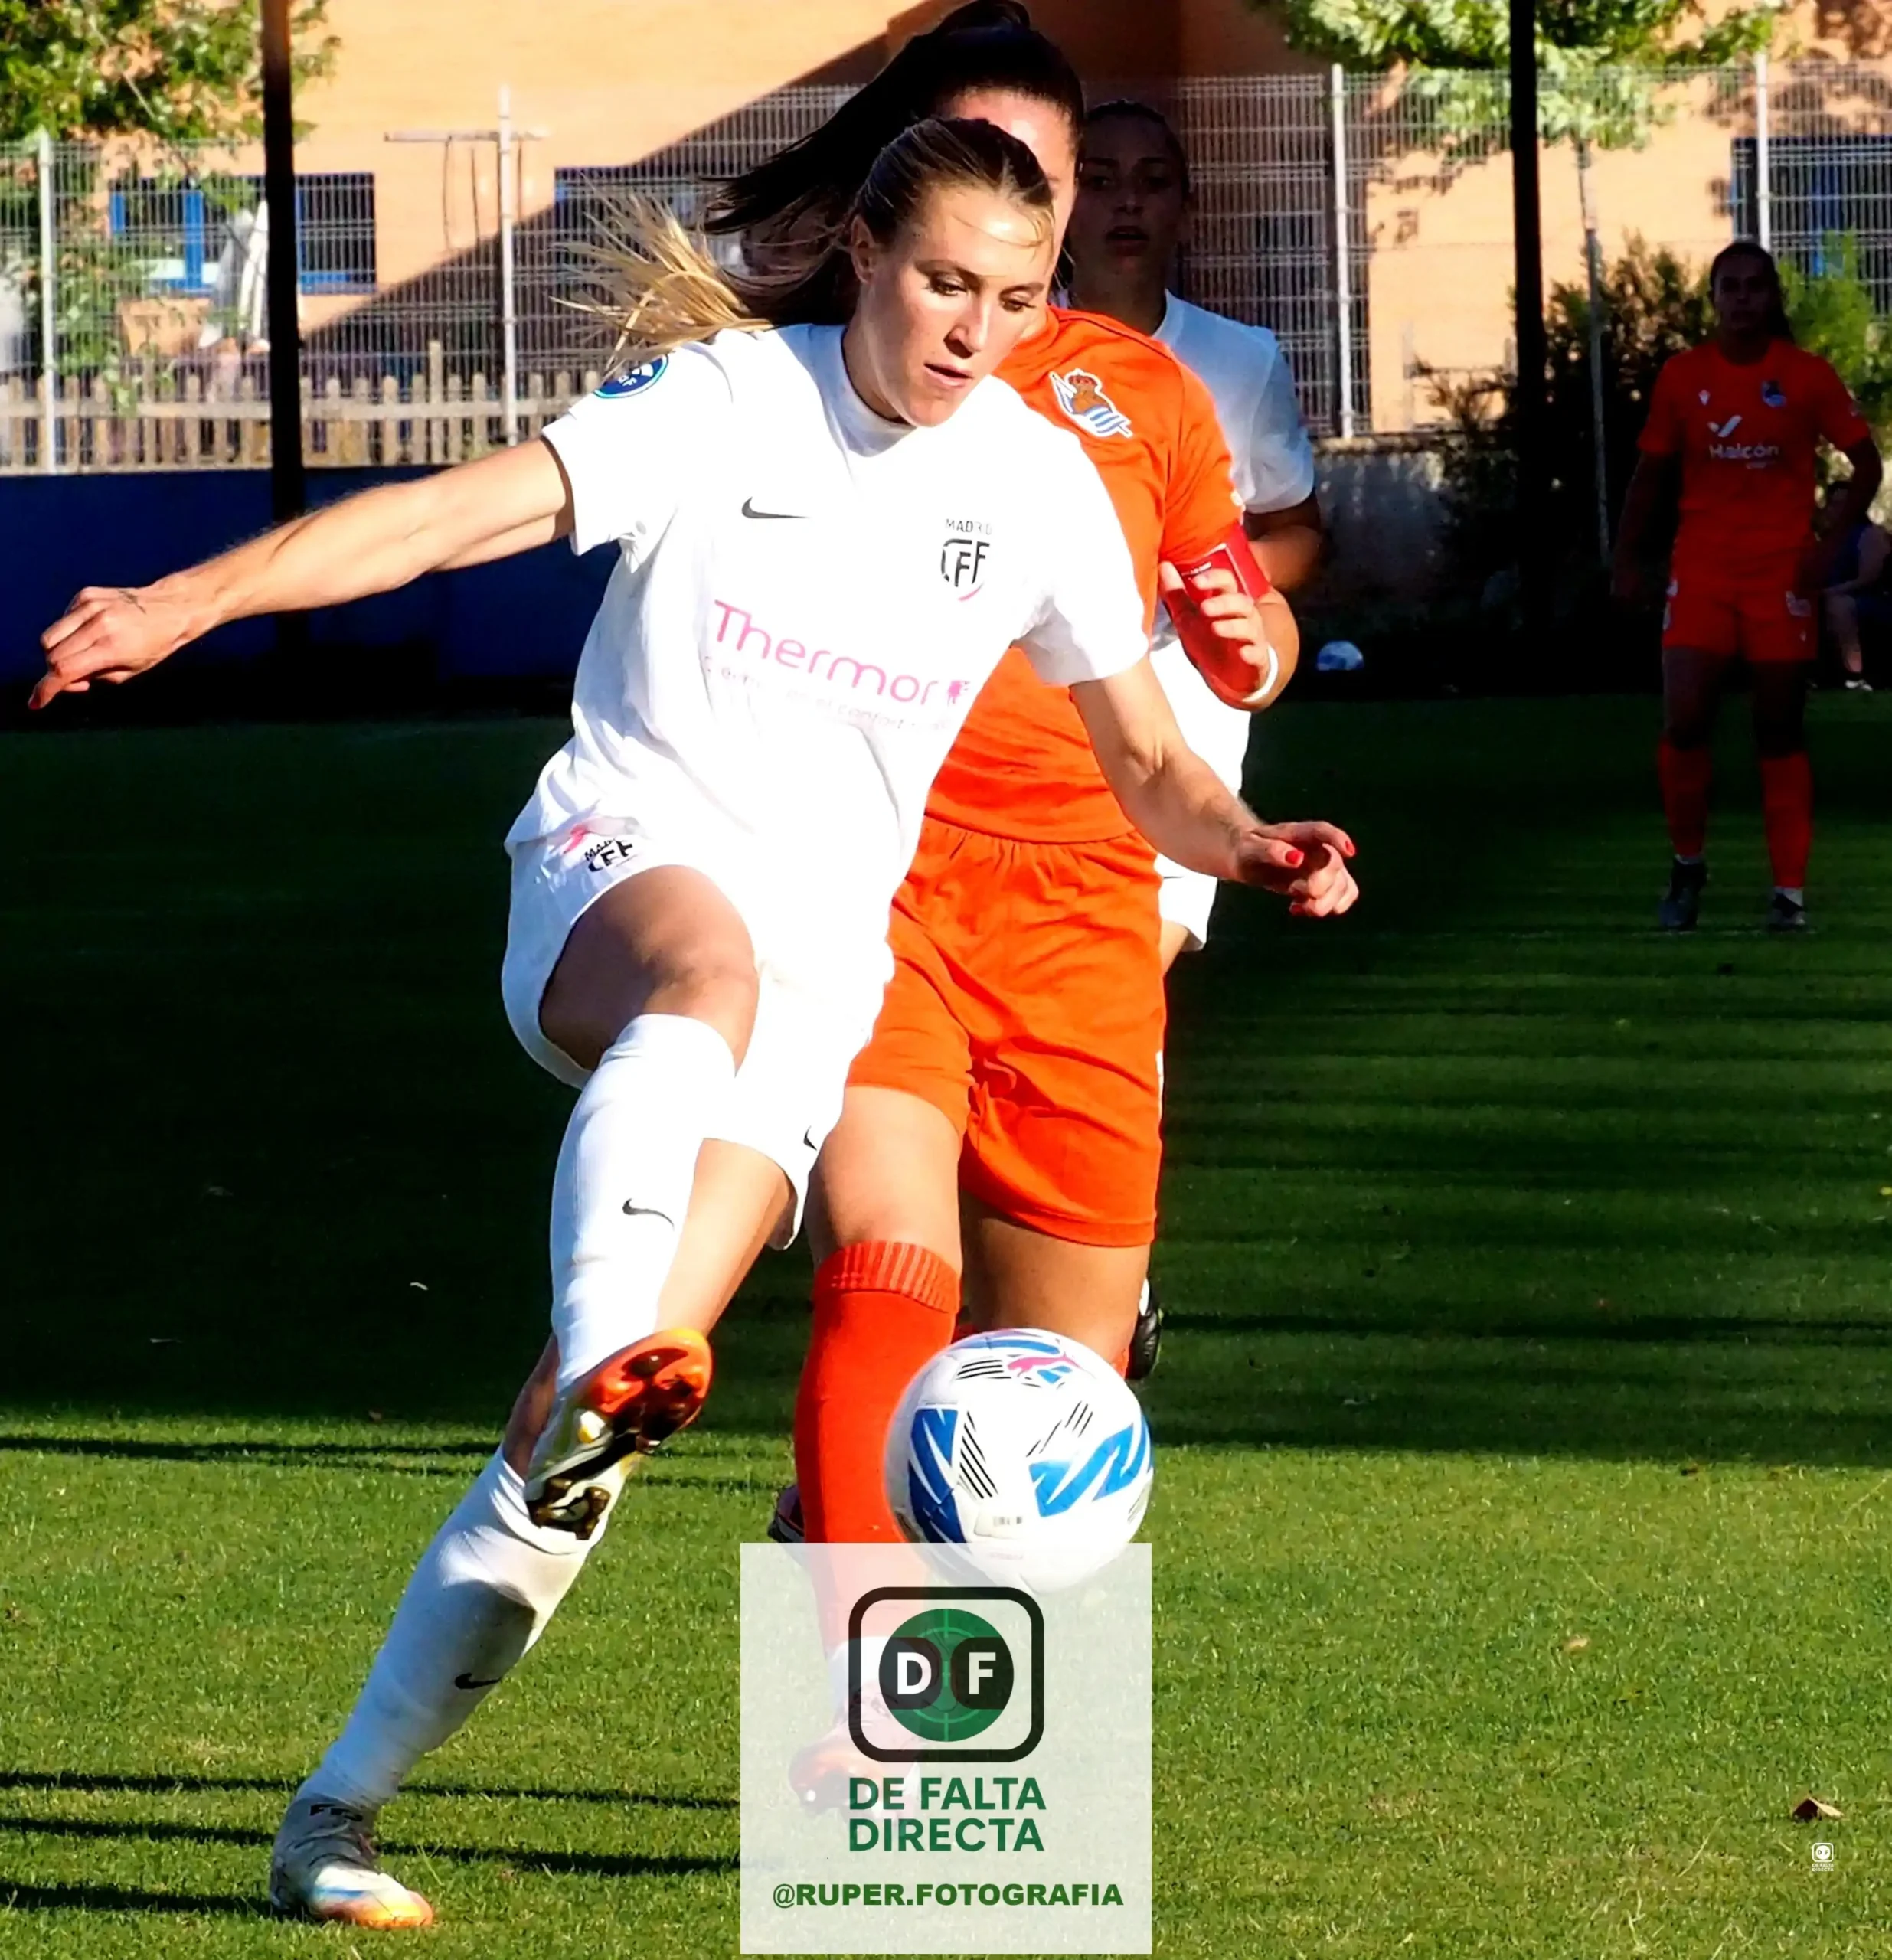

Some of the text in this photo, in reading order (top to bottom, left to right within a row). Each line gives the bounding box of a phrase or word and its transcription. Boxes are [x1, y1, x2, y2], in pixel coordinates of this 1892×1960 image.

[1708, 442, 1779, 459] Halcón
[945, 518, 993, 536] MADRD
[714, 599, 939, 705] Thermor
